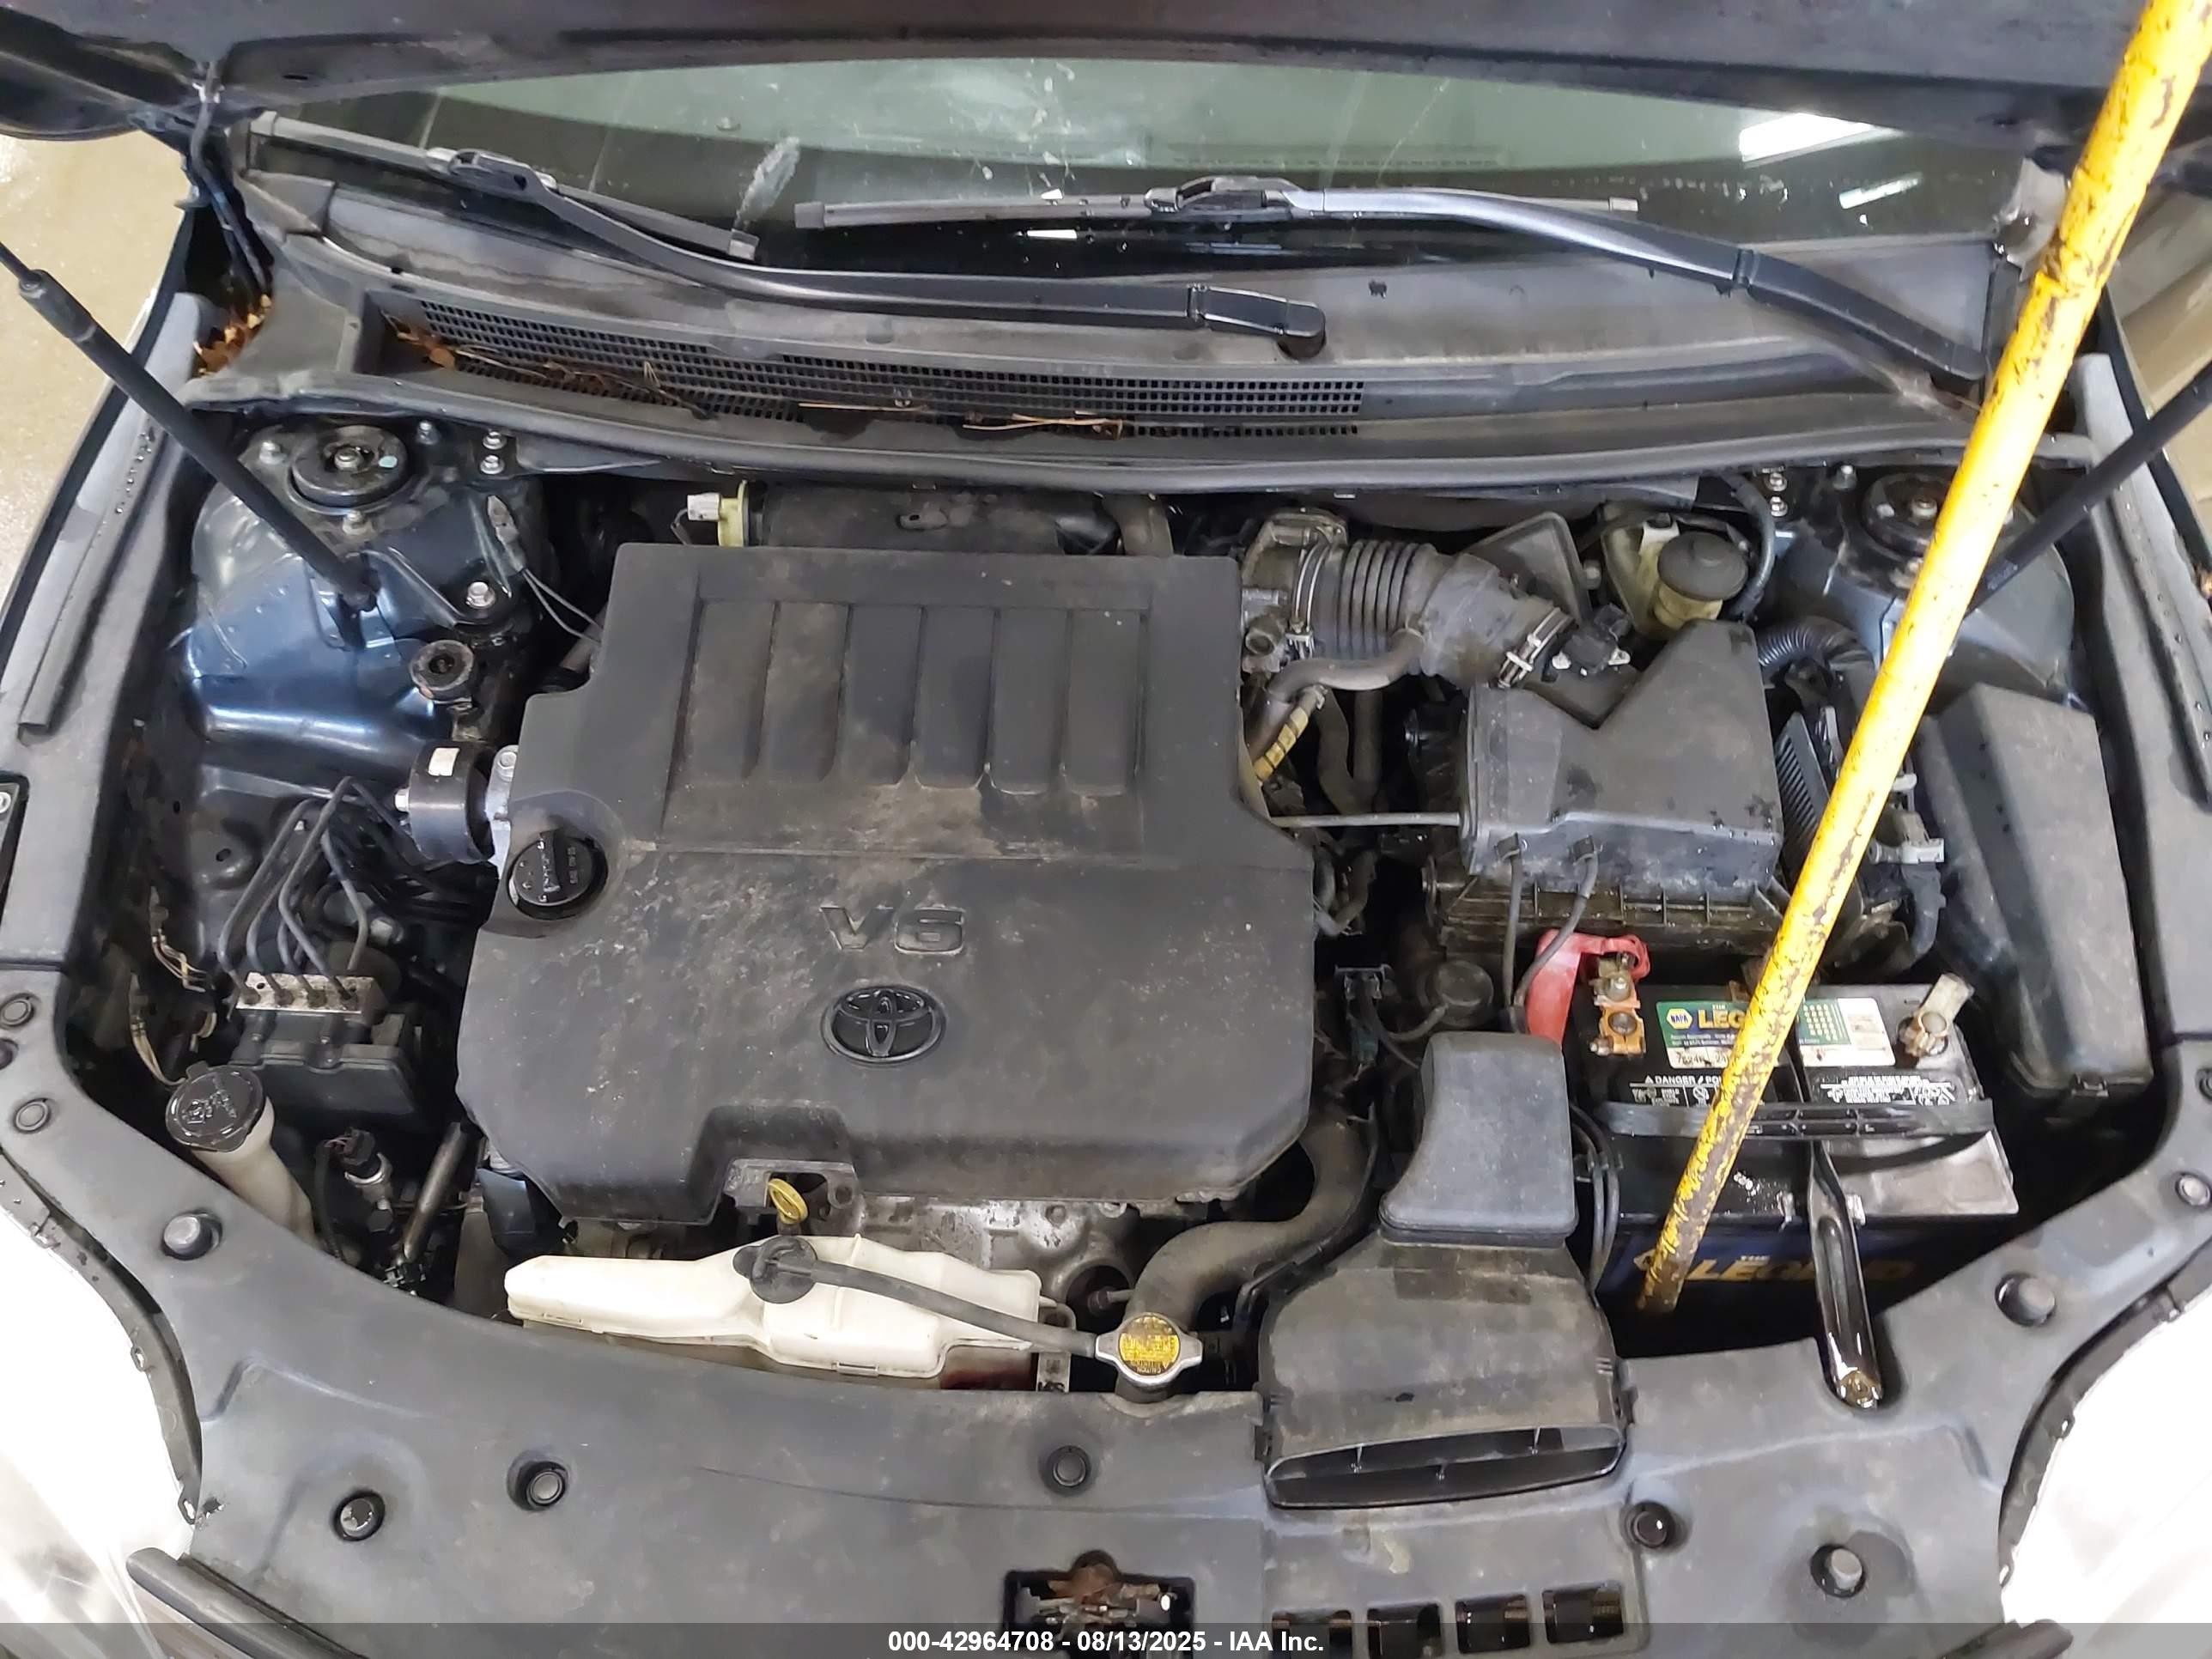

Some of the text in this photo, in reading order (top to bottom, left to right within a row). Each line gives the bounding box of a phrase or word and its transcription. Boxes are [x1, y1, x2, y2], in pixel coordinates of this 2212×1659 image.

[819, 904, 965, 956] V6
[1670, 1009, 1747, 1029] NAPA LEG
[1655, 1075, 1696, 1085] DANGER
